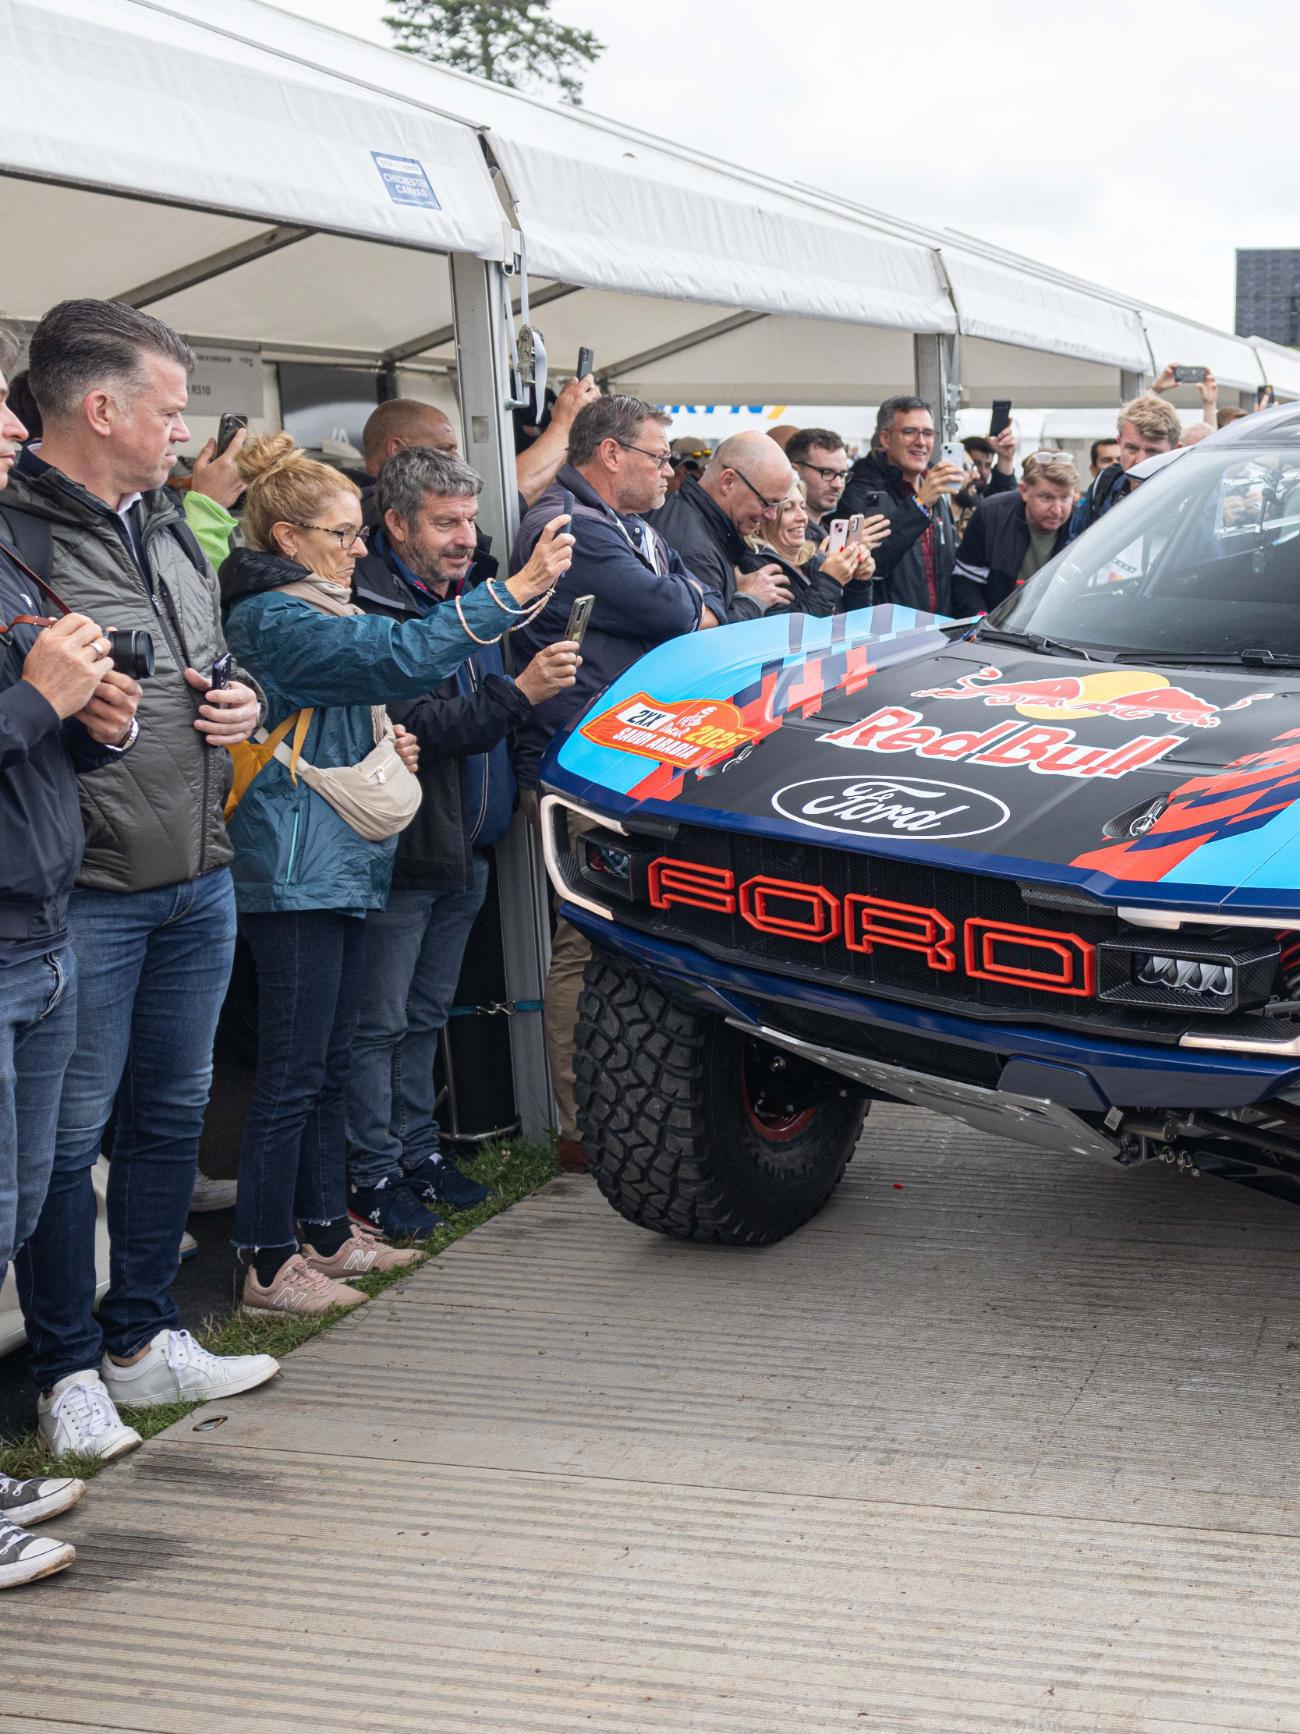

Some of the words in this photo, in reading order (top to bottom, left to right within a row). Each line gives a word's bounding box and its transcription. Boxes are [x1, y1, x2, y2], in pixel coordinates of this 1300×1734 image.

[627, 709, 666, 728] 2XX
[612, 727, 657, 746] SAUDI
[645, 736, 701, 760] ARABIA
[684, 725, 747, 750] 2025
[801, 781, 970, 832] Ford
[647, 856, 1096, 997] FORD
